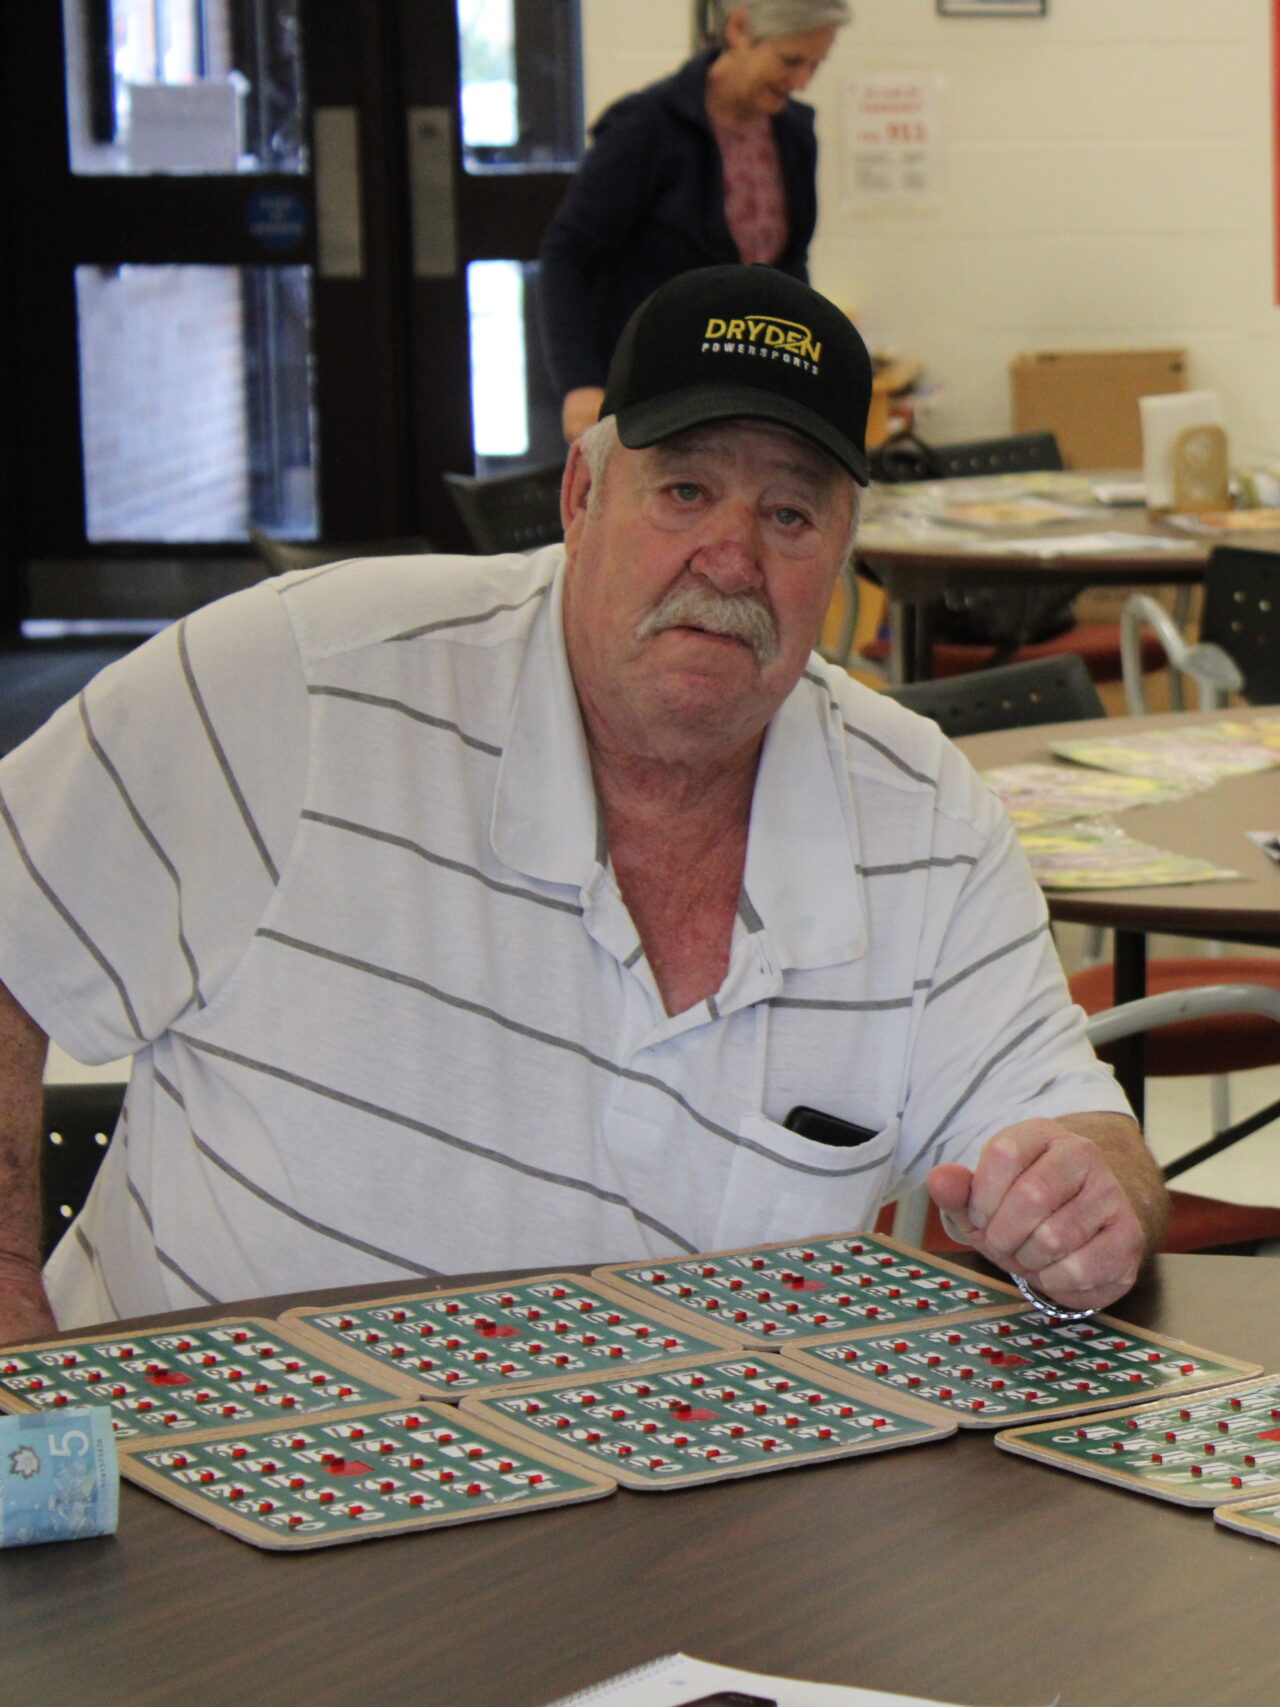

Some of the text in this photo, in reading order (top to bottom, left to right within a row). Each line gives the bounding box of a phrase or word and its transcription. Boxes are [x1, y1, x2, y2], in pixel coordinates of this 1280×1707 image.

[704, 316, 822, 362] DRYDEN
[701, 342, 820, 377] POWERSPORTS
[47, 1429, 90, 1458] 5
